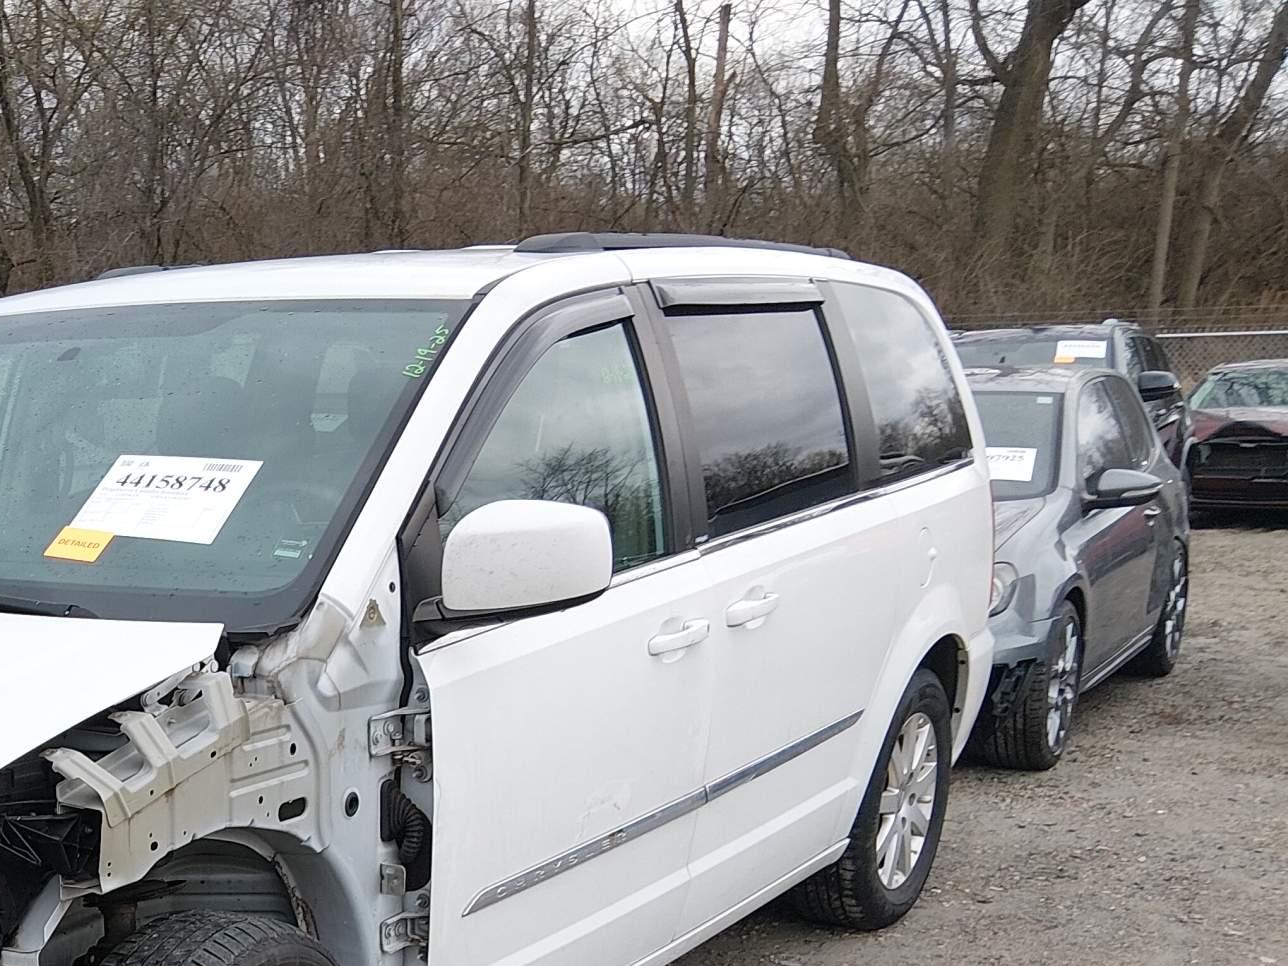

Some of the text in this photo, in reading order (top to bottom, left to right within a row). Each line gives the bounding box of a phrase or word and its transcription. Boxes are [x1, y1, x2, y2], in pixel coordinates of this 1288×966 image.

[402, 324, 449, 378] 12-19-25
[116, 472, 231, 493] 44158748
[58, 538, 100, 549] DETAILED
[496, 831, 627, 898] CHRYSLER
